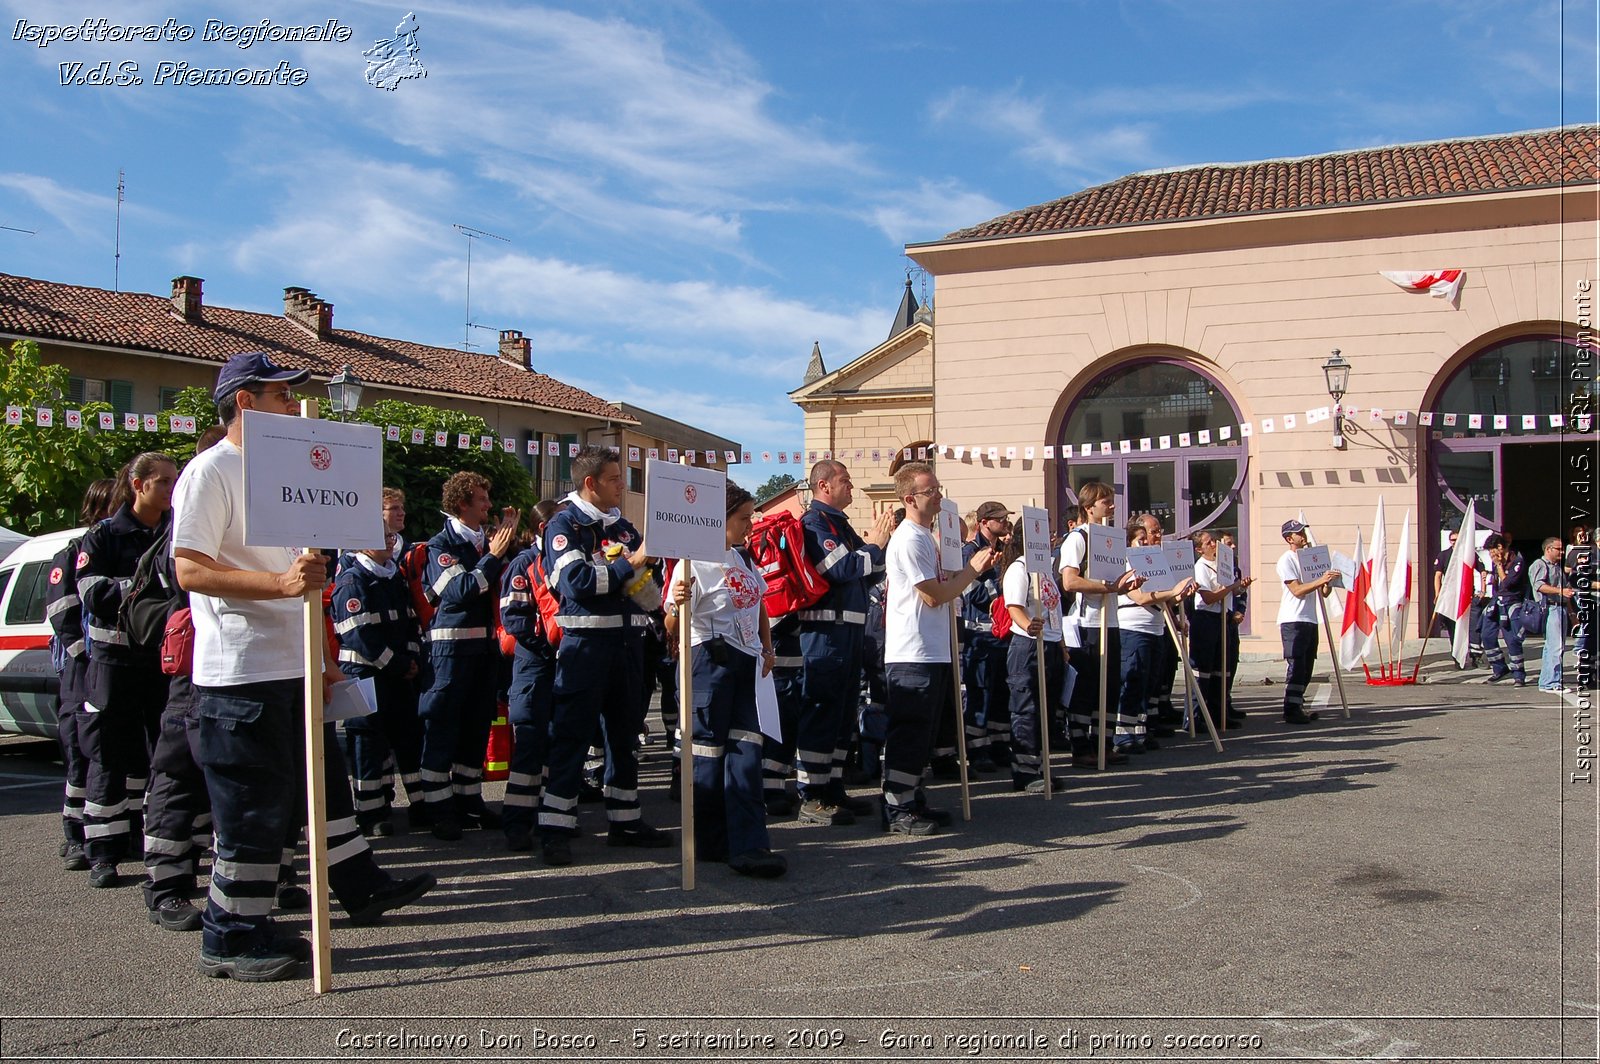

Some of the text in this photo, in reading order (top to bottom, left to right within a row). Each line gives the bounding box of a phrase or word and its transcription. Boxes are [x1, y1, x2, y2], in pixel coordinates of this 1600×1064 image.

[281, 486, 359, 507] BAVENO
[656, 511, 723, 528] BORGOMANERO
[1093, 553, 1125, 565] MONCALVO
